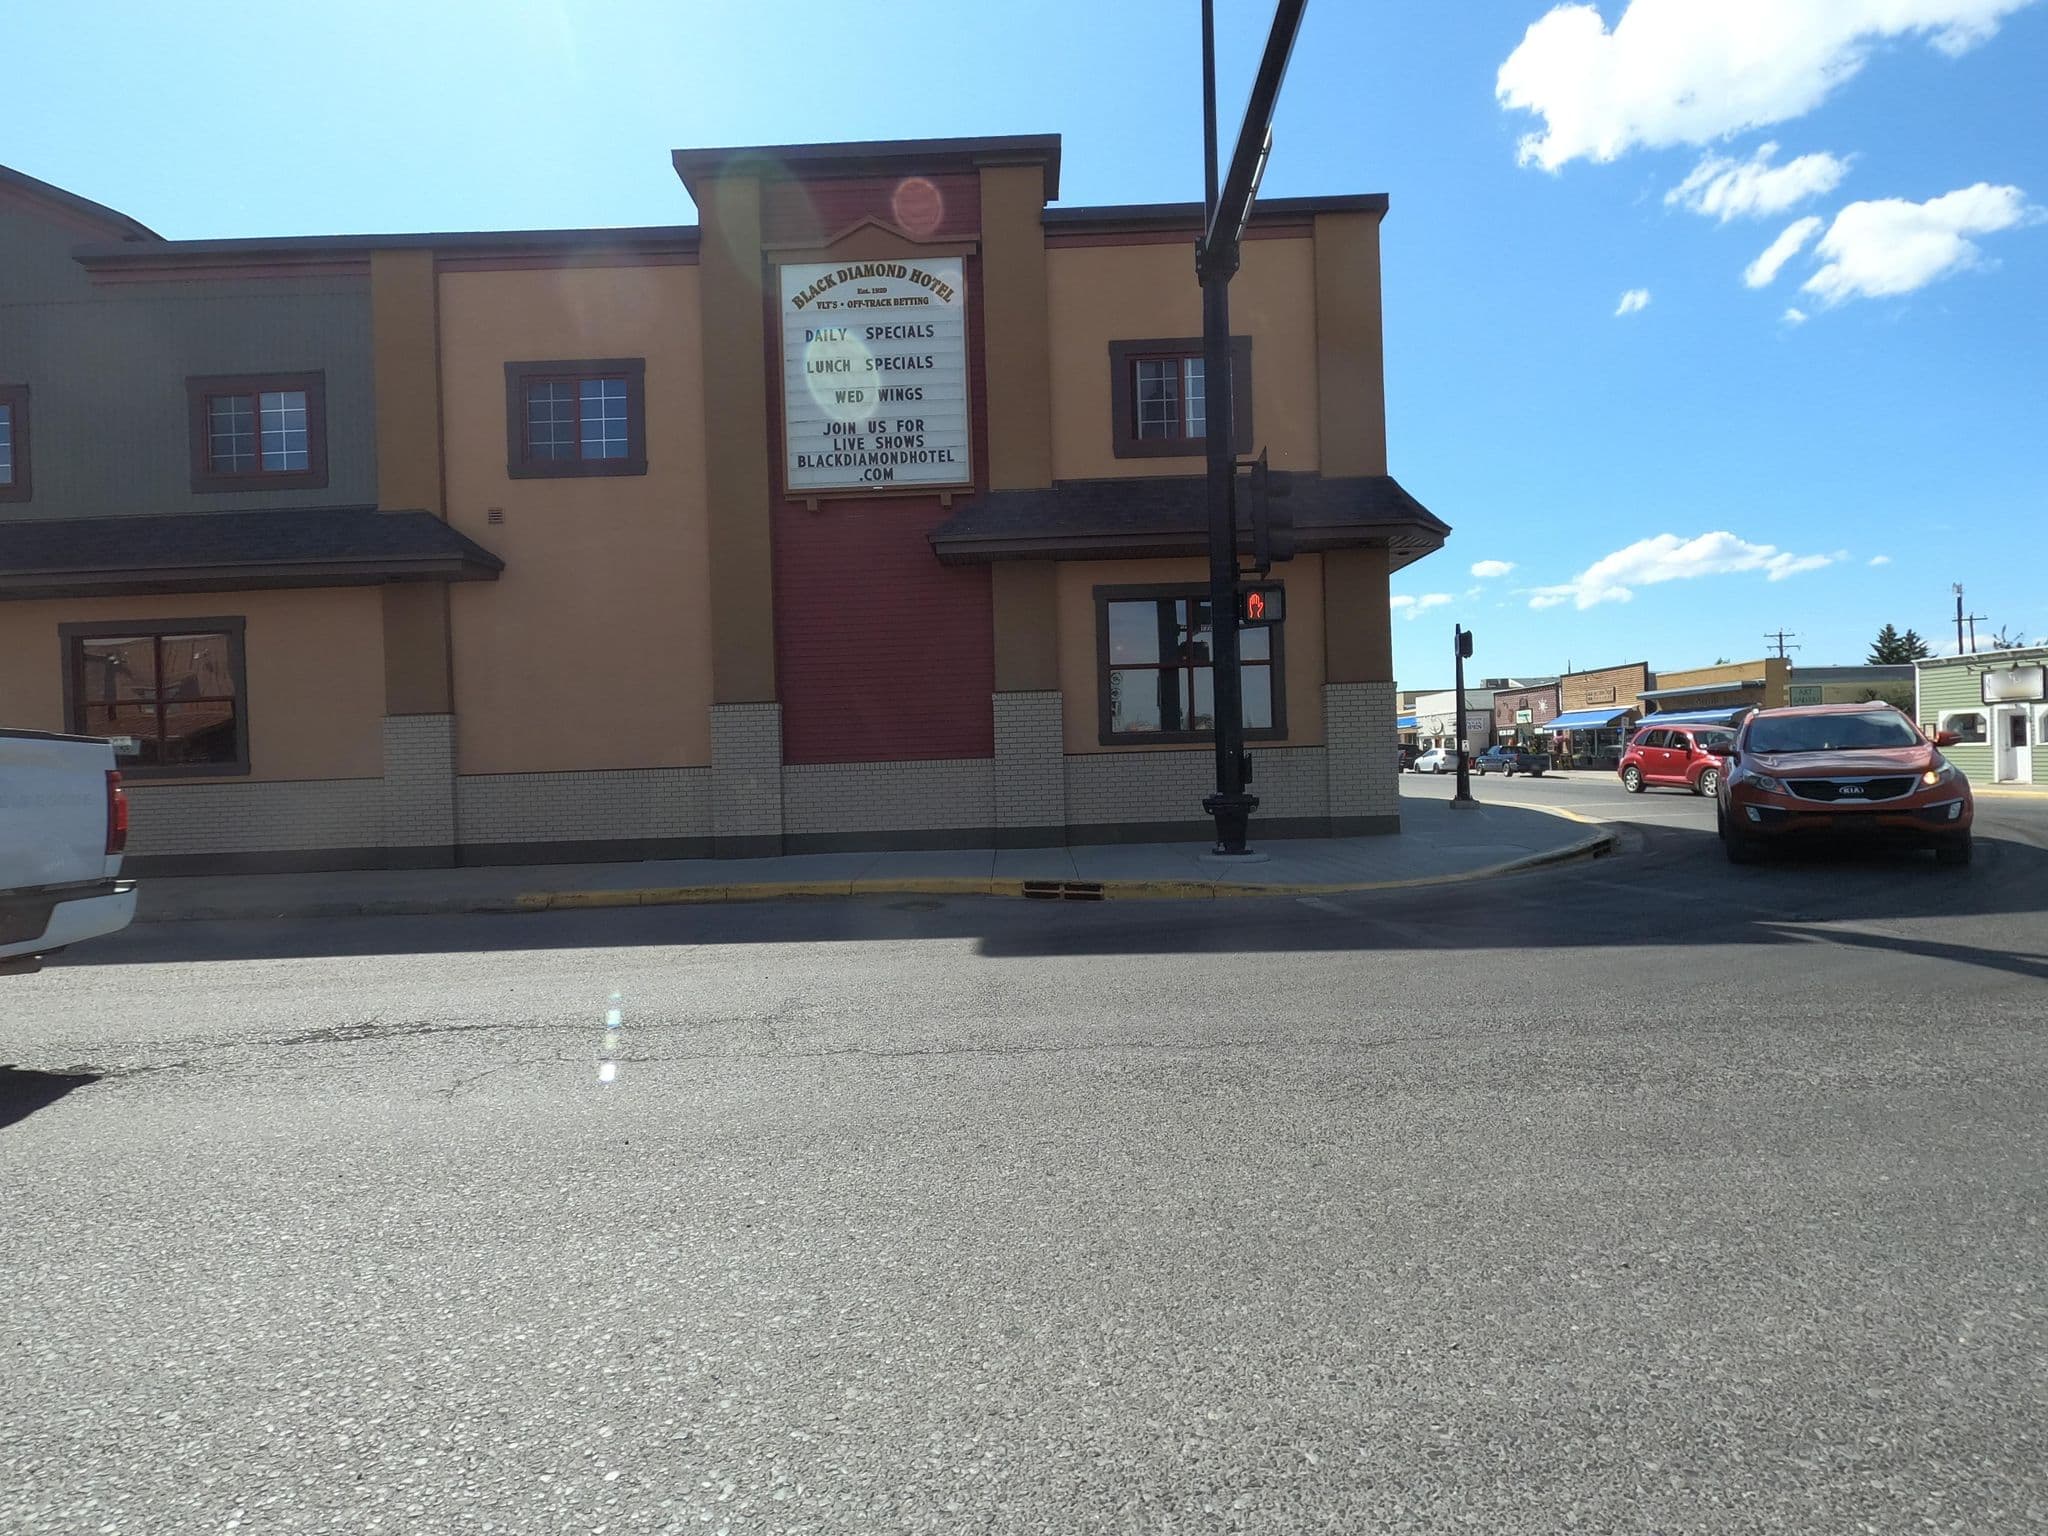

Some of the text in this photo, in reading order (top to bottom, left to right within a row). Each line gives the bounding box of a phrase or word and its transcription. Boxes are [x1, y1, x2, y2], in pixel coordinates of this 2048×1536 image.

[791, 263, 955, 310] BLACK DIAMOND HOTEL
[847, 298, 892, 309] OFF-TRACK
[893, 296, 929, 307] BETTING
[805, 324, 935, 342] DAILY SPECIALS
[807, 356, 934, 374] LUNCH SPECIALS
[835, 387, 924, 404] WED WINGS
[822, 419, 925, 436] JOIN US FOR
[833, 435, 924, 451] LIVE SHOWS
[797, 450, 955, 468] BLACKDIAMONDHOTEL
[859, 468, 894, 482] .COM
[1841, 786, 1862, 794] KIA
